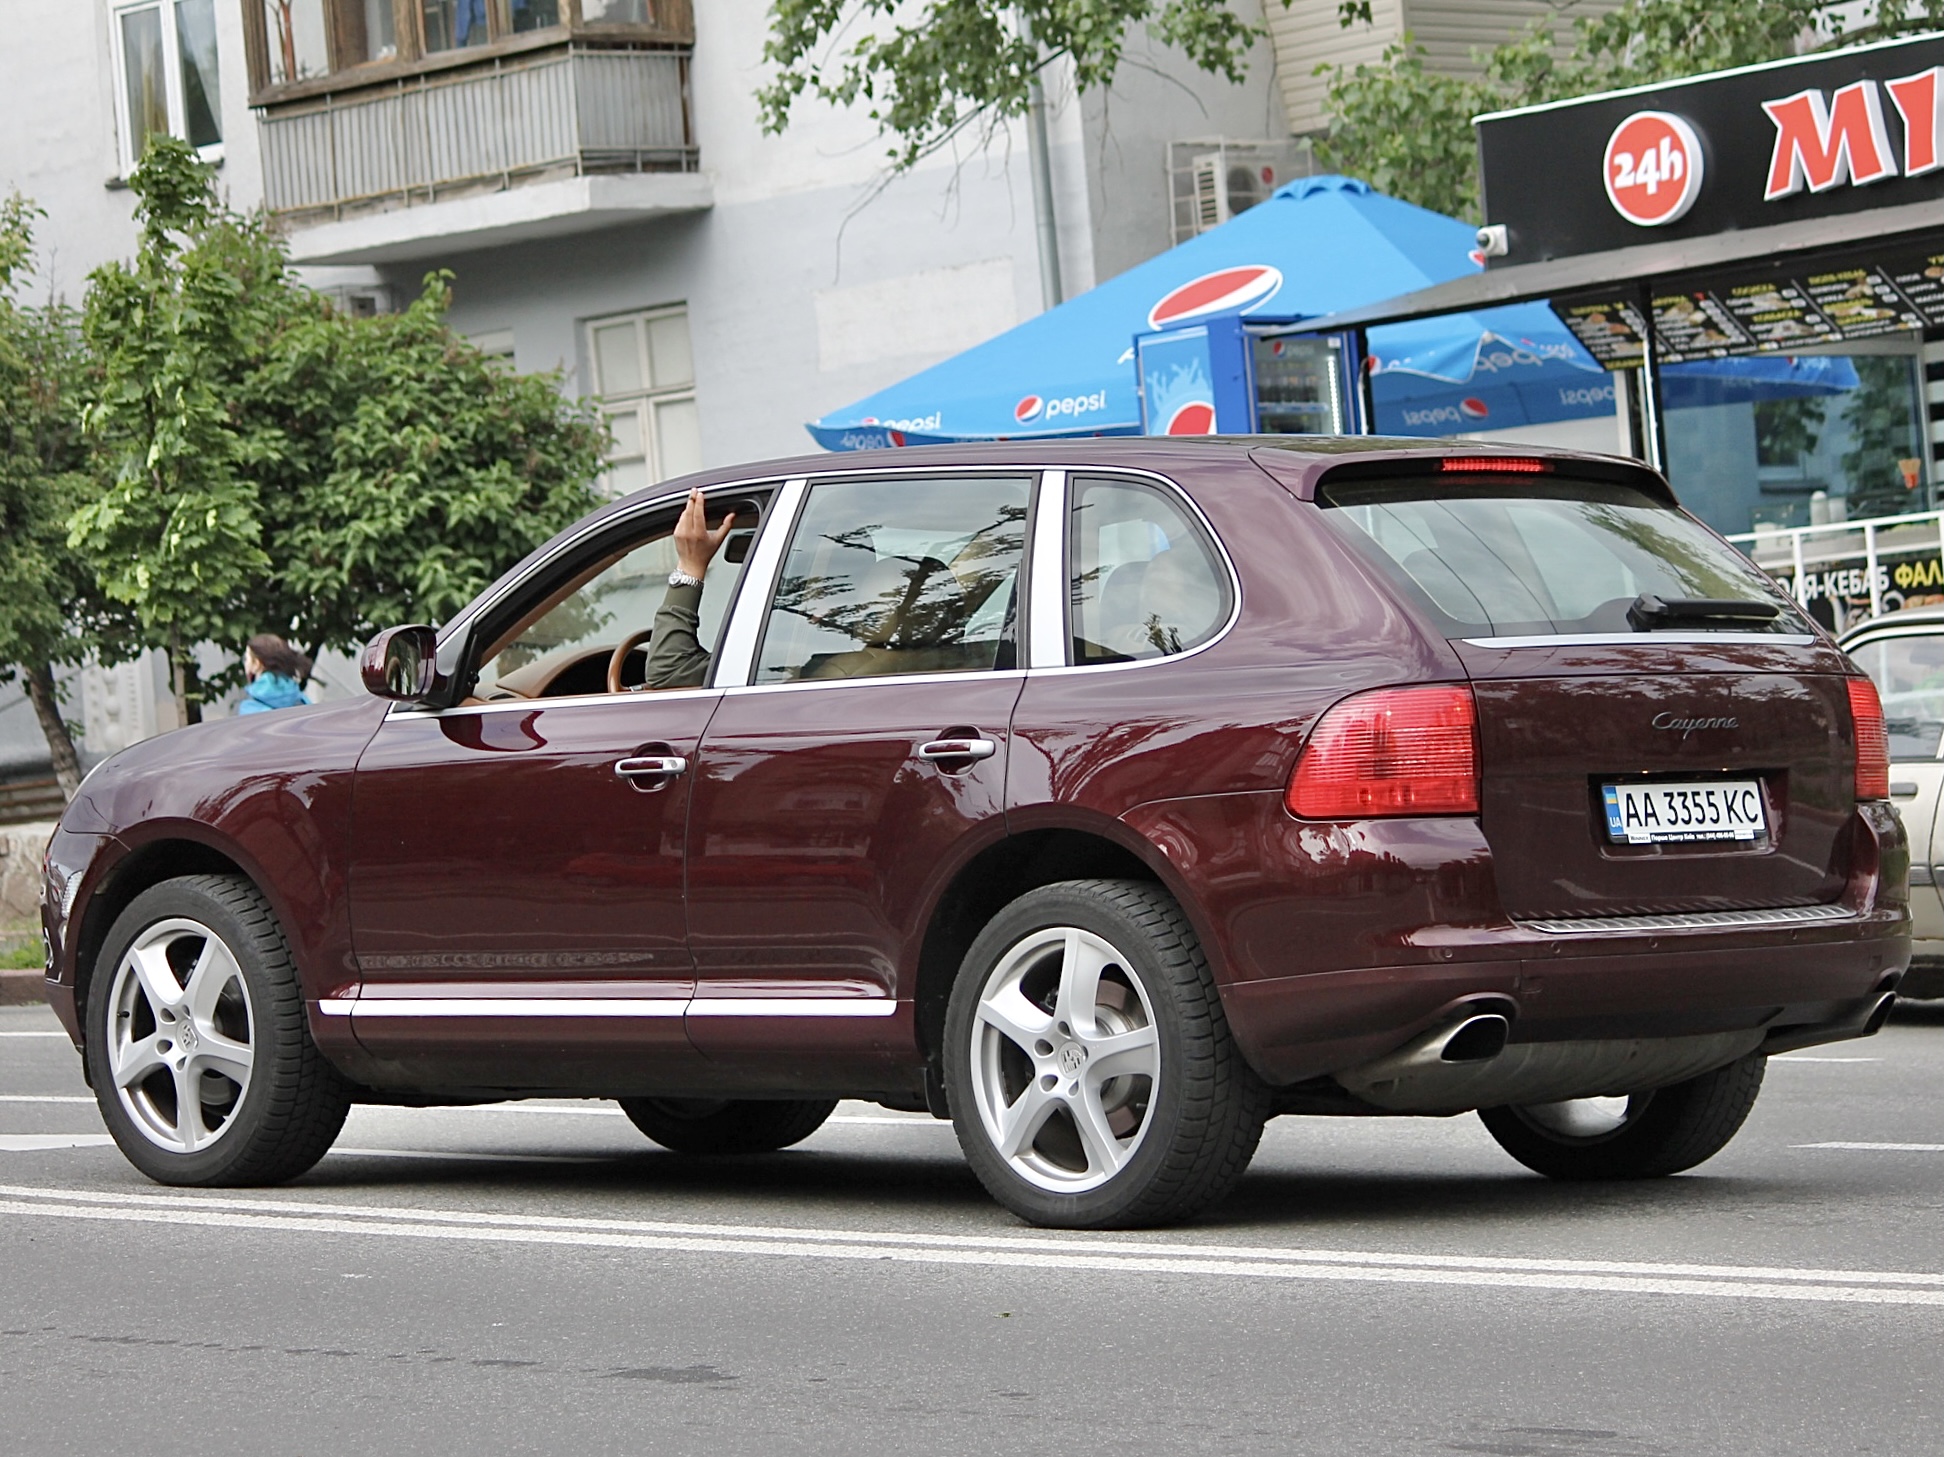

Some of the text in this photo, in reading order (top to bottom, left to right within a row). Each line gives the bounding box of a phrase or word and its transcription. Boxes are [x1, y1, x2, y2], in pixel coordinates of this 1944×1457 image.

[1613, 136, 1684, 196] 24h
[1045, 389, 1106, 420] pepsi
[1651, 711, 1740, 740] Cayenne
[1609, 816, 1622, 828] UA
[1625, 789, 1759, 828] AA 3355 KC
